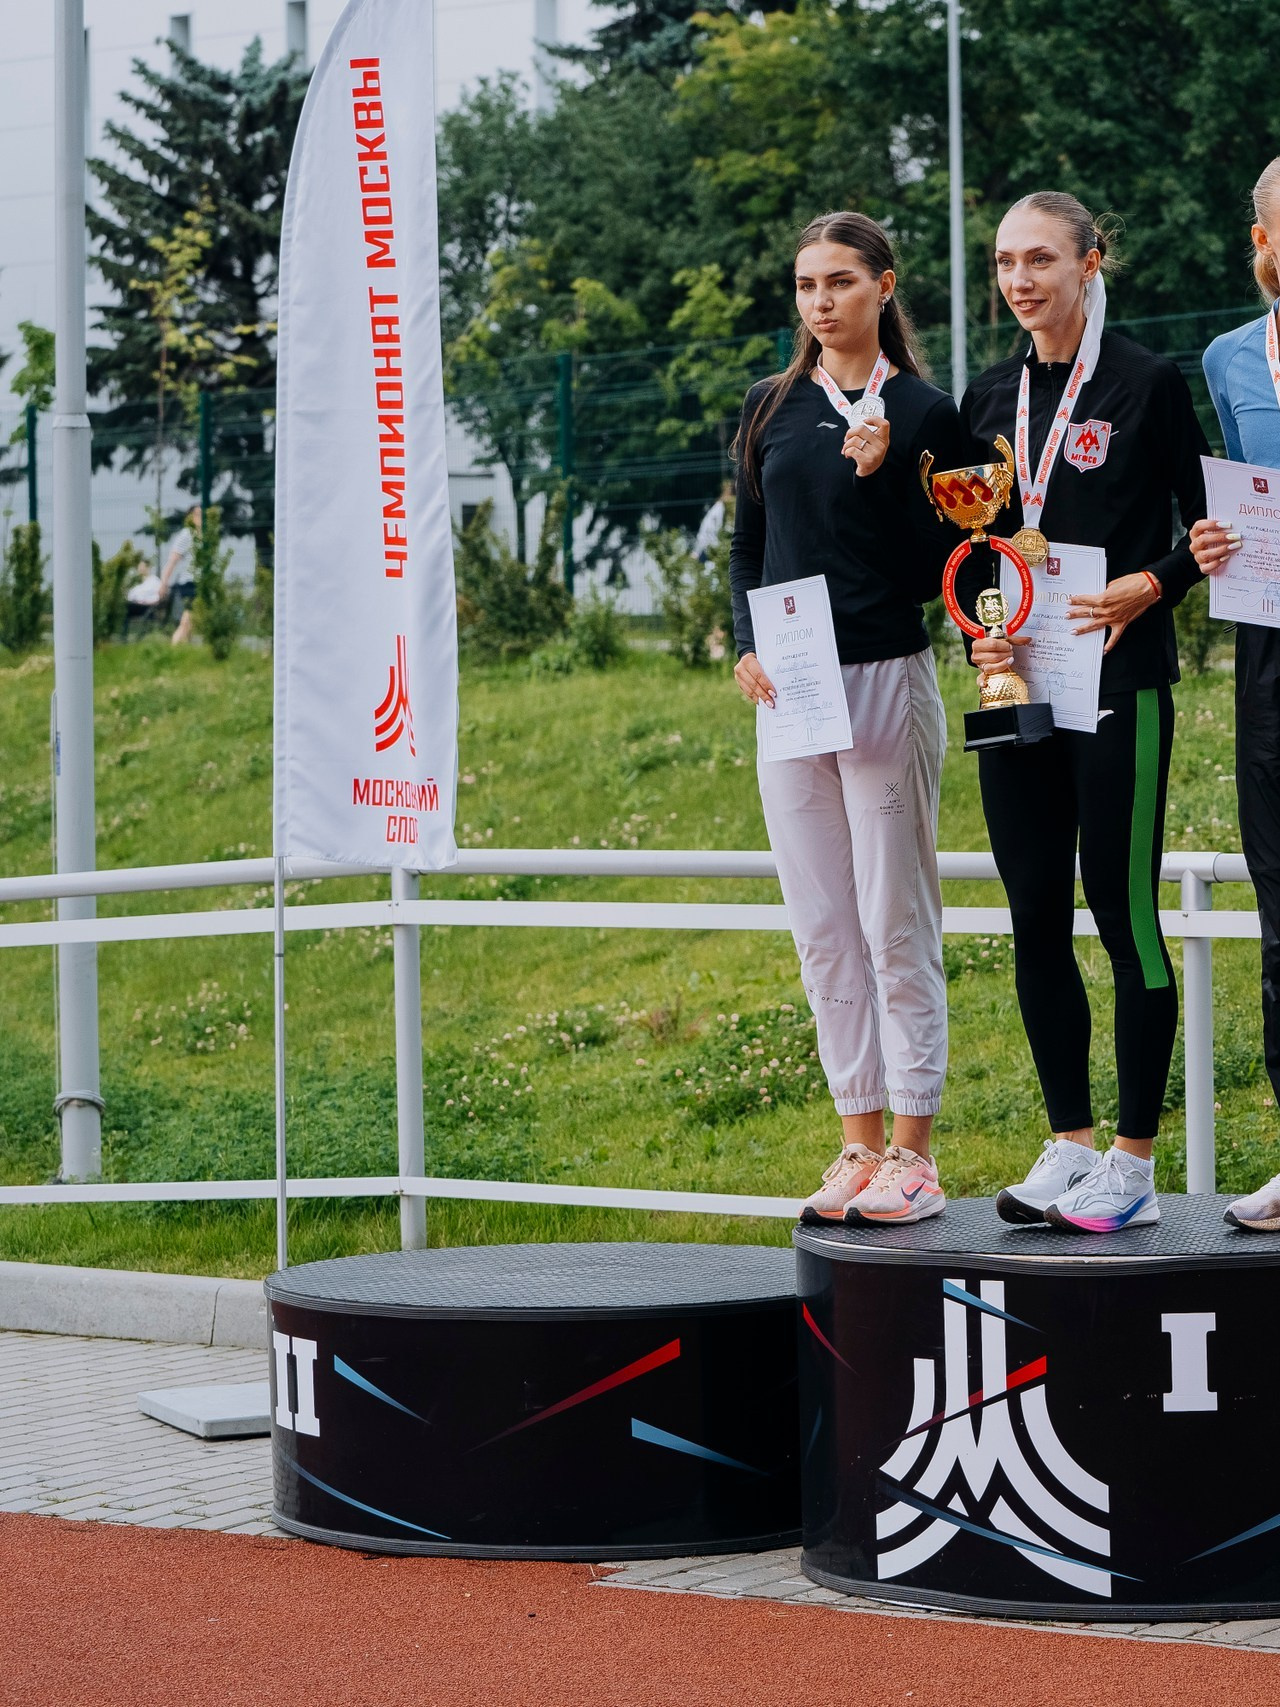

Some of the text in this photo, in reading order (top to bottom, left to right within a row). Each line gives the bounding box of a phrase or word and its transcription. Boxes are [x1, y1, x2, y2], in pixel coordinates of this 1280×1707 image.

[350, 58, 408, 579] ЧЕМПИОНАТ МОСКВЫ
[1038, 428, 1061, 484] МОСКОВСКИЙ СПОРТ
[775, 627, 814, 647] ДИПЛОМ
[834, 998, 854, 1006] WADE
[273, 1330, 320, 1437] II
[1161, 1312, 1219, 1412] I
